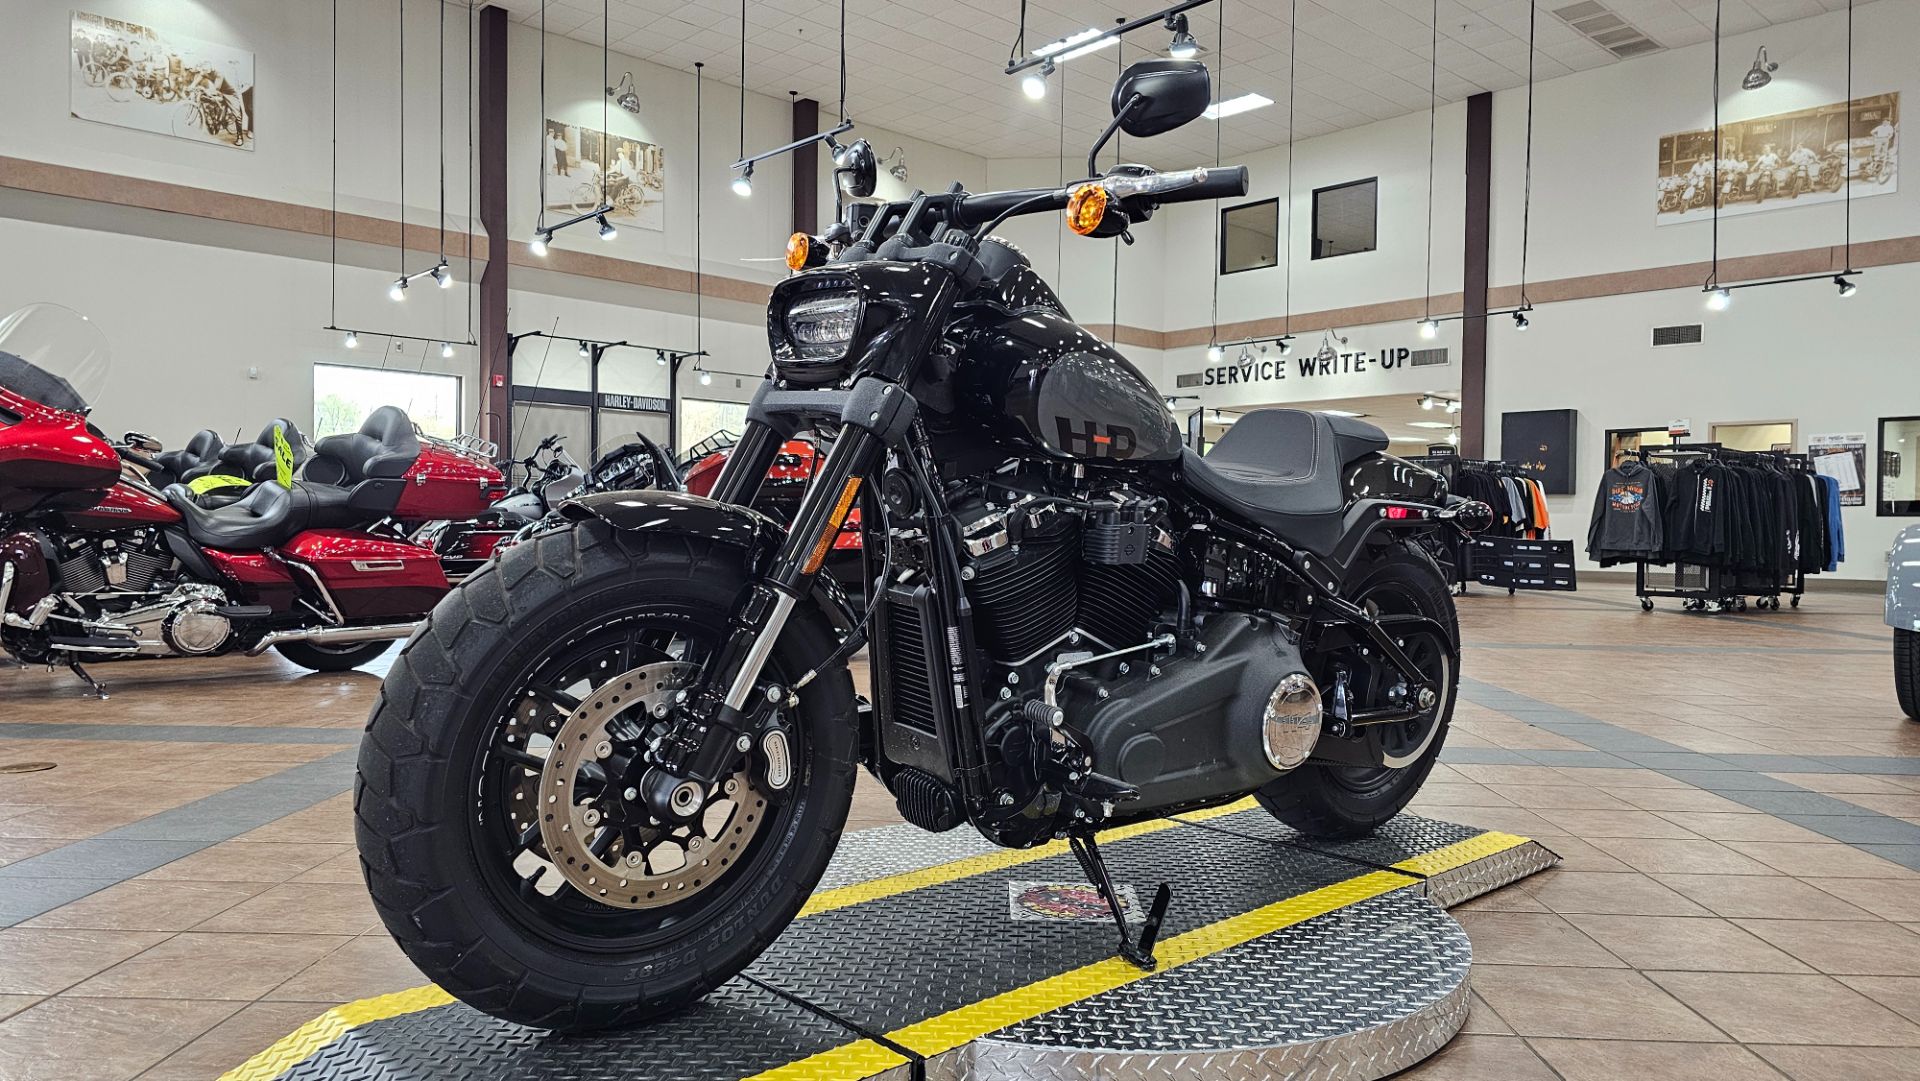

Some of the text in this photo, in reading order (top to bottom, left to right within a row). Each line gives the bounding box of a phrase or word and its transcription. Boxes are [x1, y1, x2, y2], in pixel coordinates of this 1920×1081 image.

[1204, 347, 1410, 386] SERVICE WRITE-UP
[707, 873, 785, 952] DUNLOP
